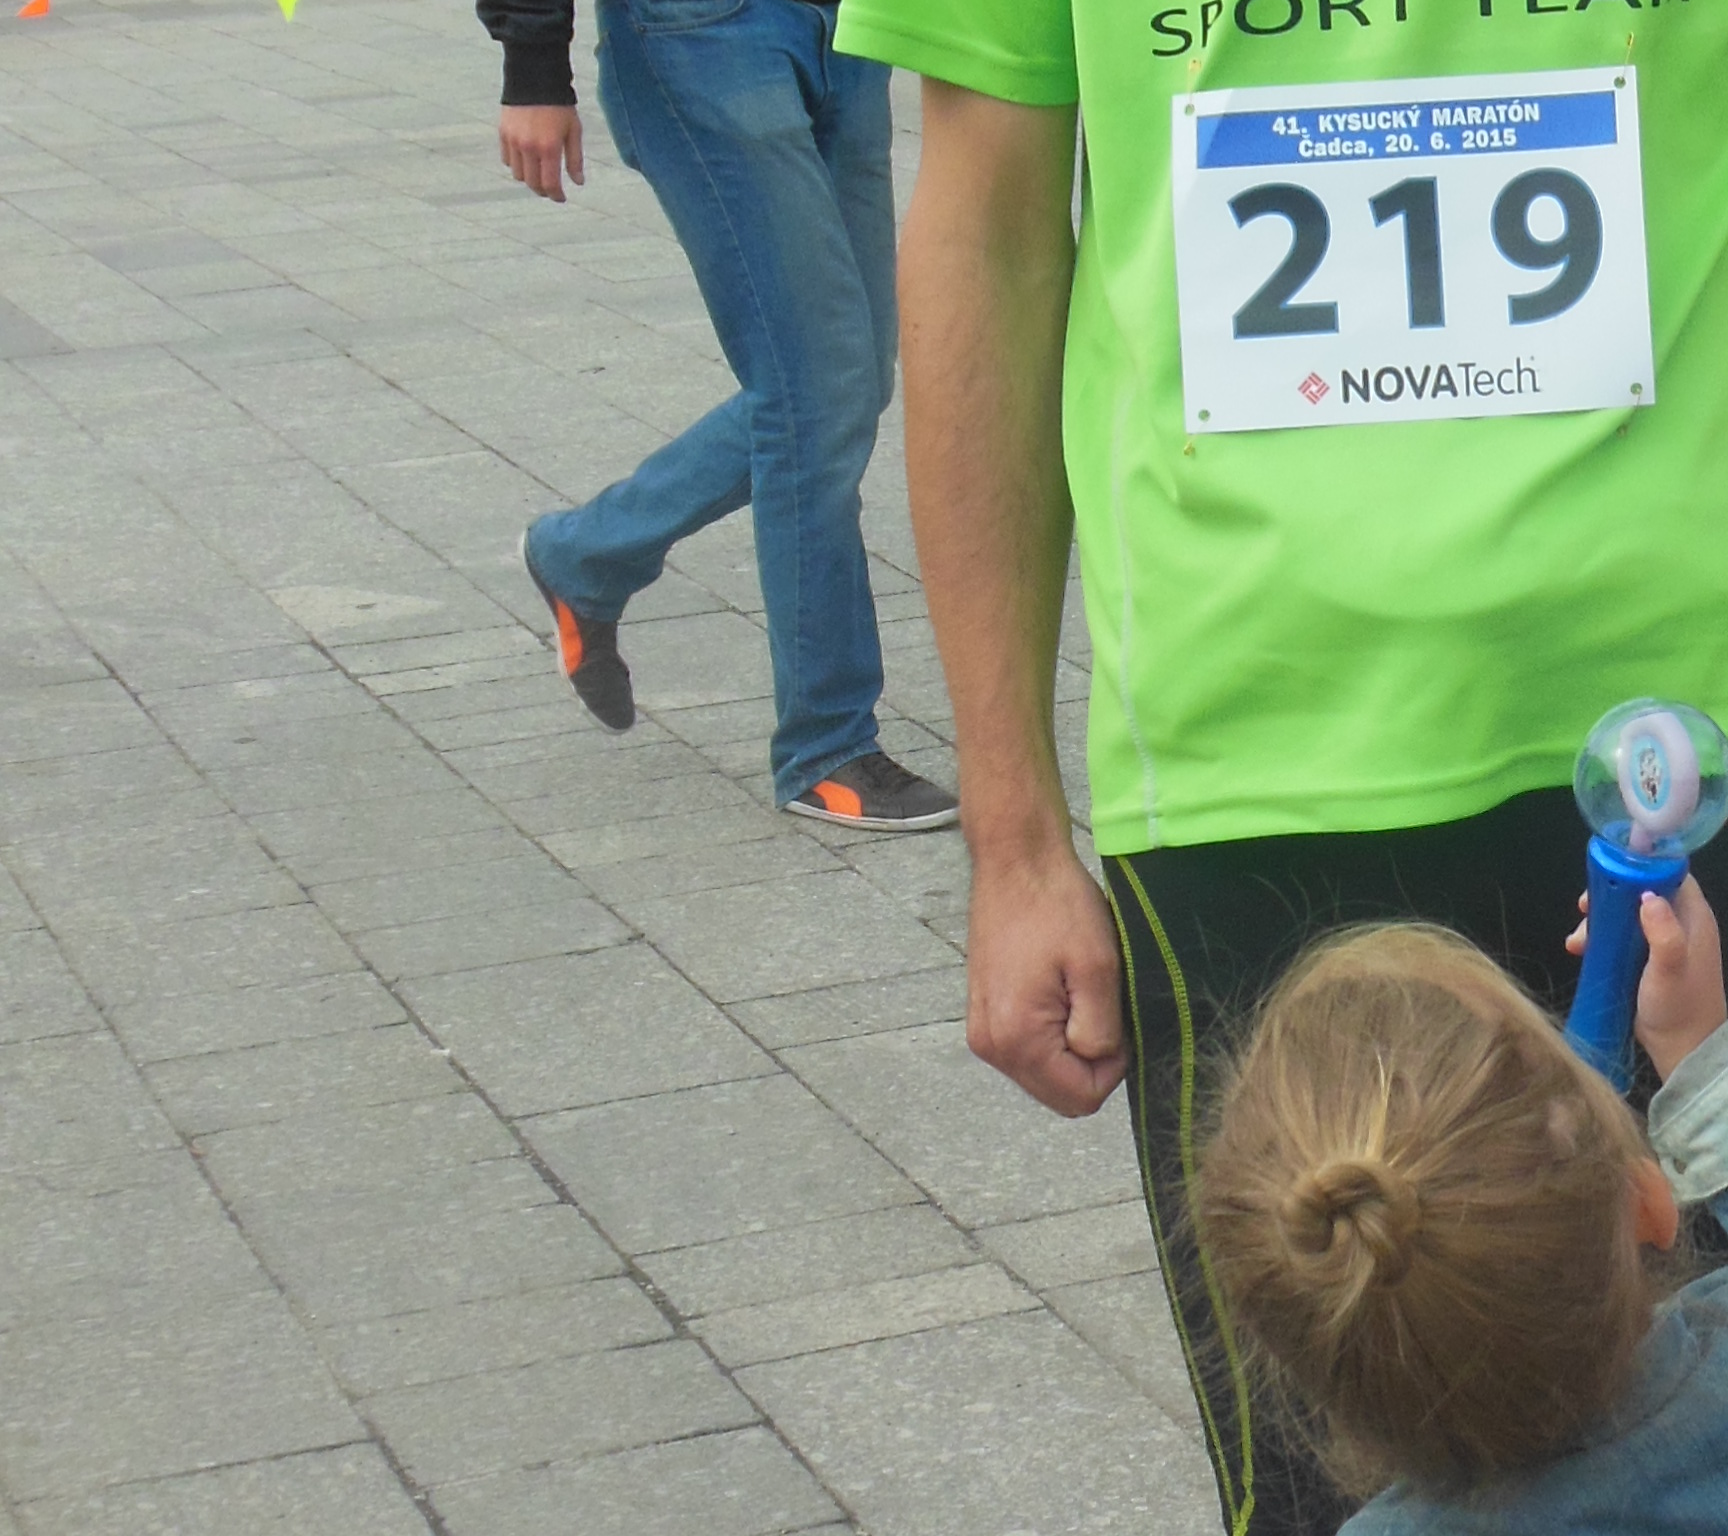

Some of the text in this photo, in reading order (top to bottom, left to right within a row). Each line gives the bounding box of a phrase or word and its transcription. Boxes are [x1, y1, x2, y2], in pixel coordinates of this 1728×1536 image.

[1272, 99, 1541, 135] 41. KYSUCKÝ MARATÓN
[1298, 127, 1518, 158] Čadca, 20. 6. 2015
[1226, 166, 1605, 341] 219
[1340, 357, 1541, 404] NOVATech
